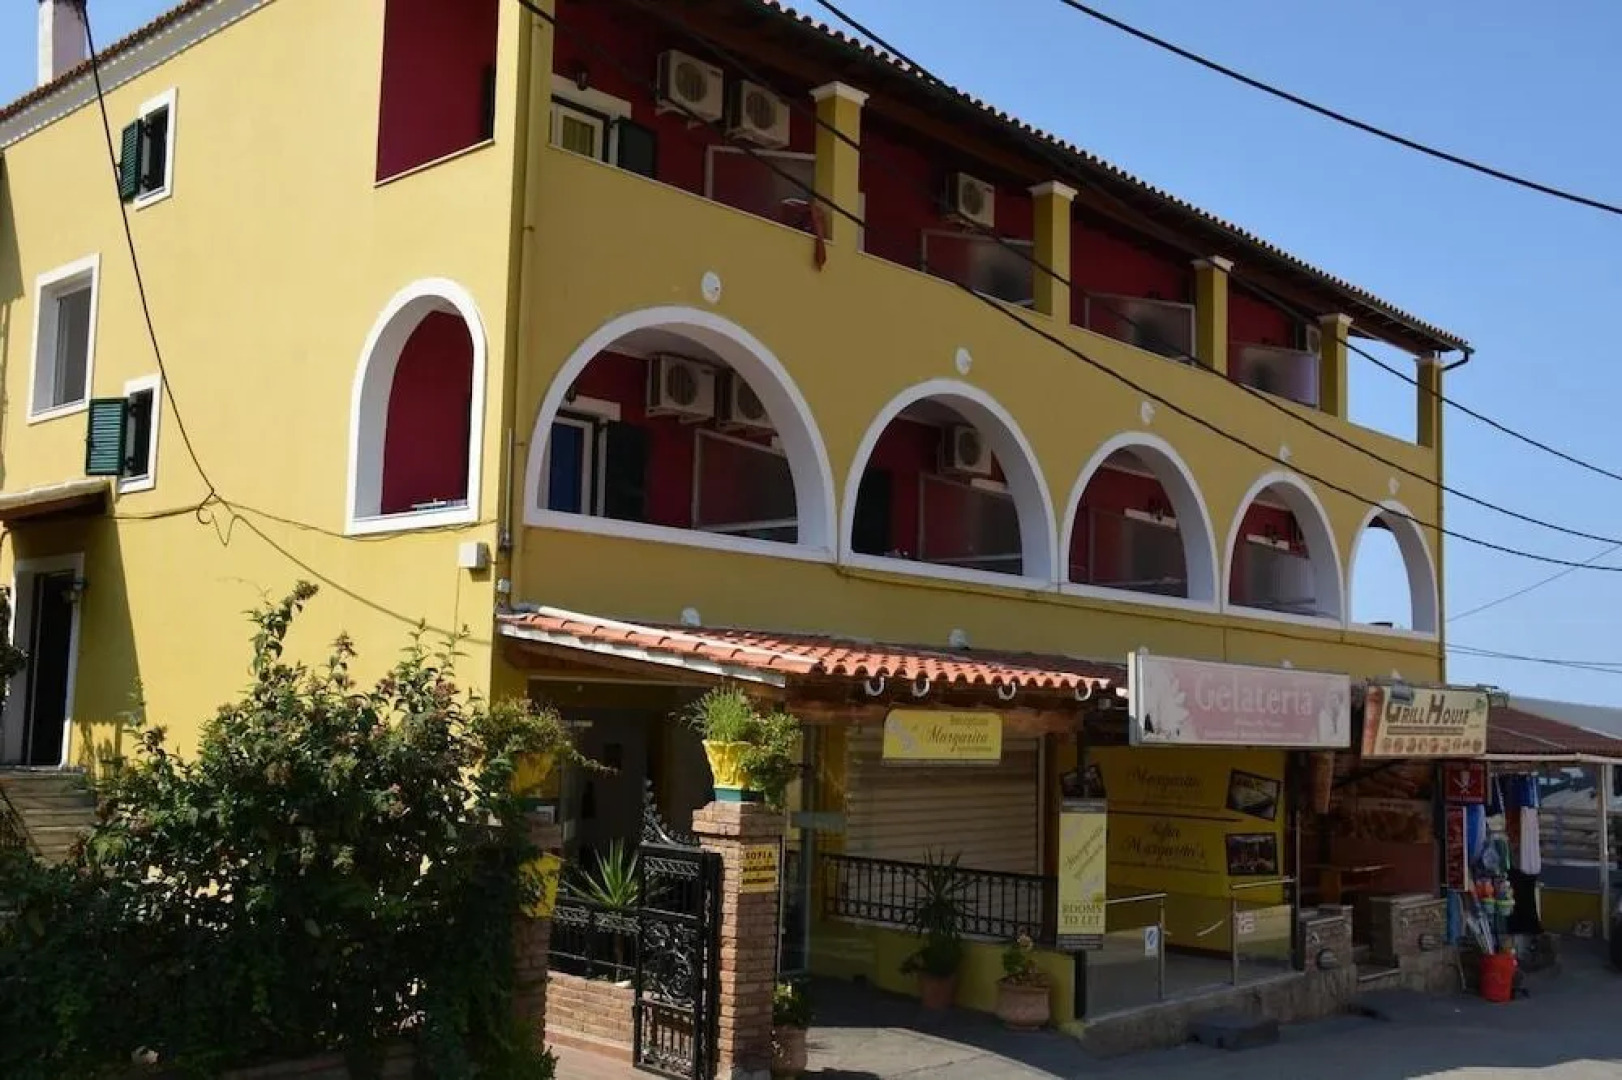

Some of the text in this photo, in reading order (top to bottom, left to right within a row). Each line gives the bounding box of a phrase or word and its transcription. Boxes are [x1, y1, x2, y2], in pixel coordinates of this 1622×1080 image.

[1195, 673, 1314, 716] Gelateria
[1386, 693, 1469, 725] GRILL HOUSE
[1062, 903, 1102, 914] ROOMS
[1063, 915, 1101, 925] TO LET
